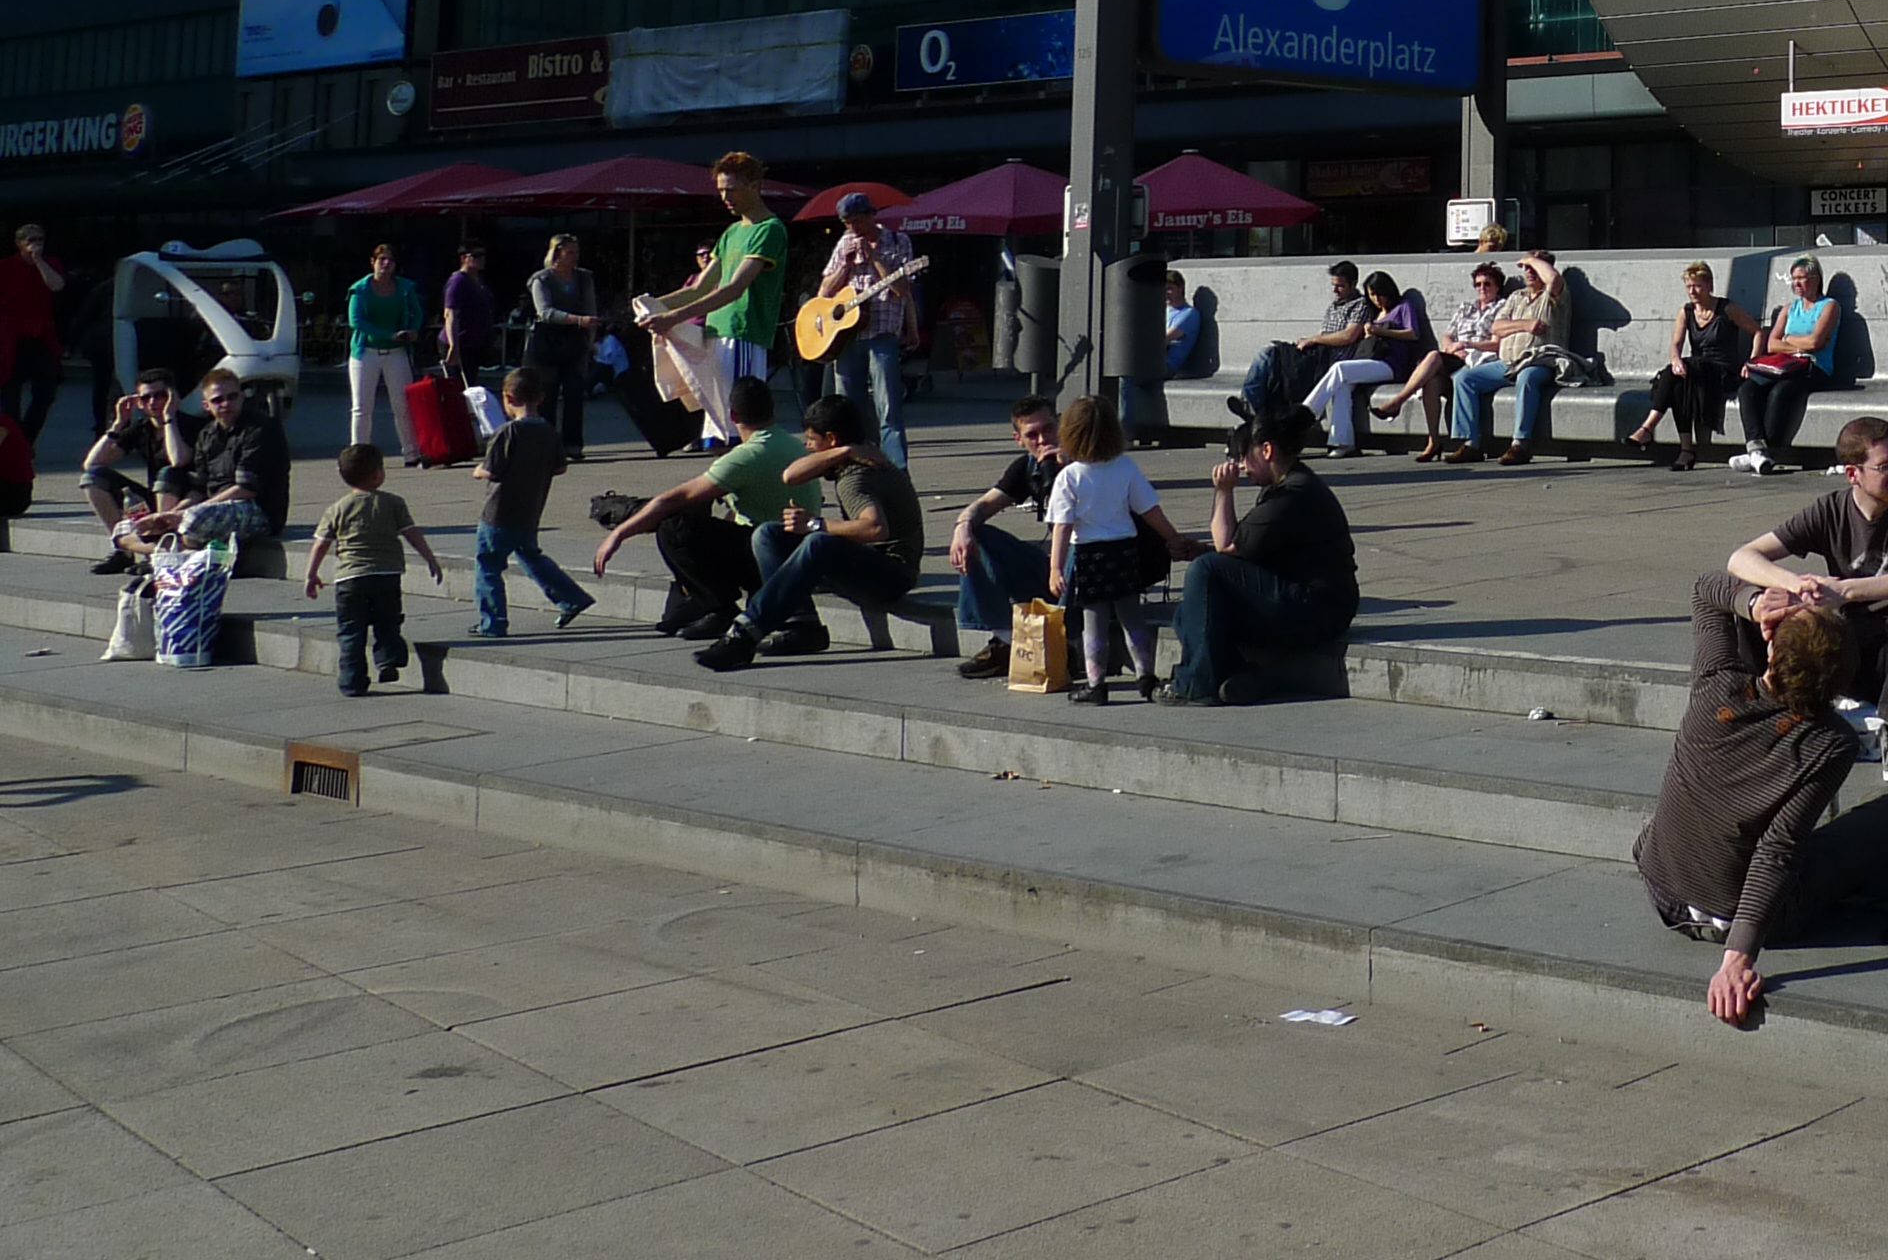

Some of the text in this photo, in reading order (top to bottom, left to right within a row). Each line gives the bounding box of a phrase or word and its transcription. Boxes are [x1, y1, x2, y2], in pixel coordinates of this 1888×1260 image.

[1212, 13, 1436, 78] Alexanderplatz
[527, 51, 584, 79] Bistro
[0, 113, 118, 159] RGER KING
[1820, 188, 1878, 201] CONCERT
[1820, 202, 1878, 214] TICKETS
[899, 215, 967, 232] Janny's Eis
[1153, 210, 1254, 229] Janny's Eis
